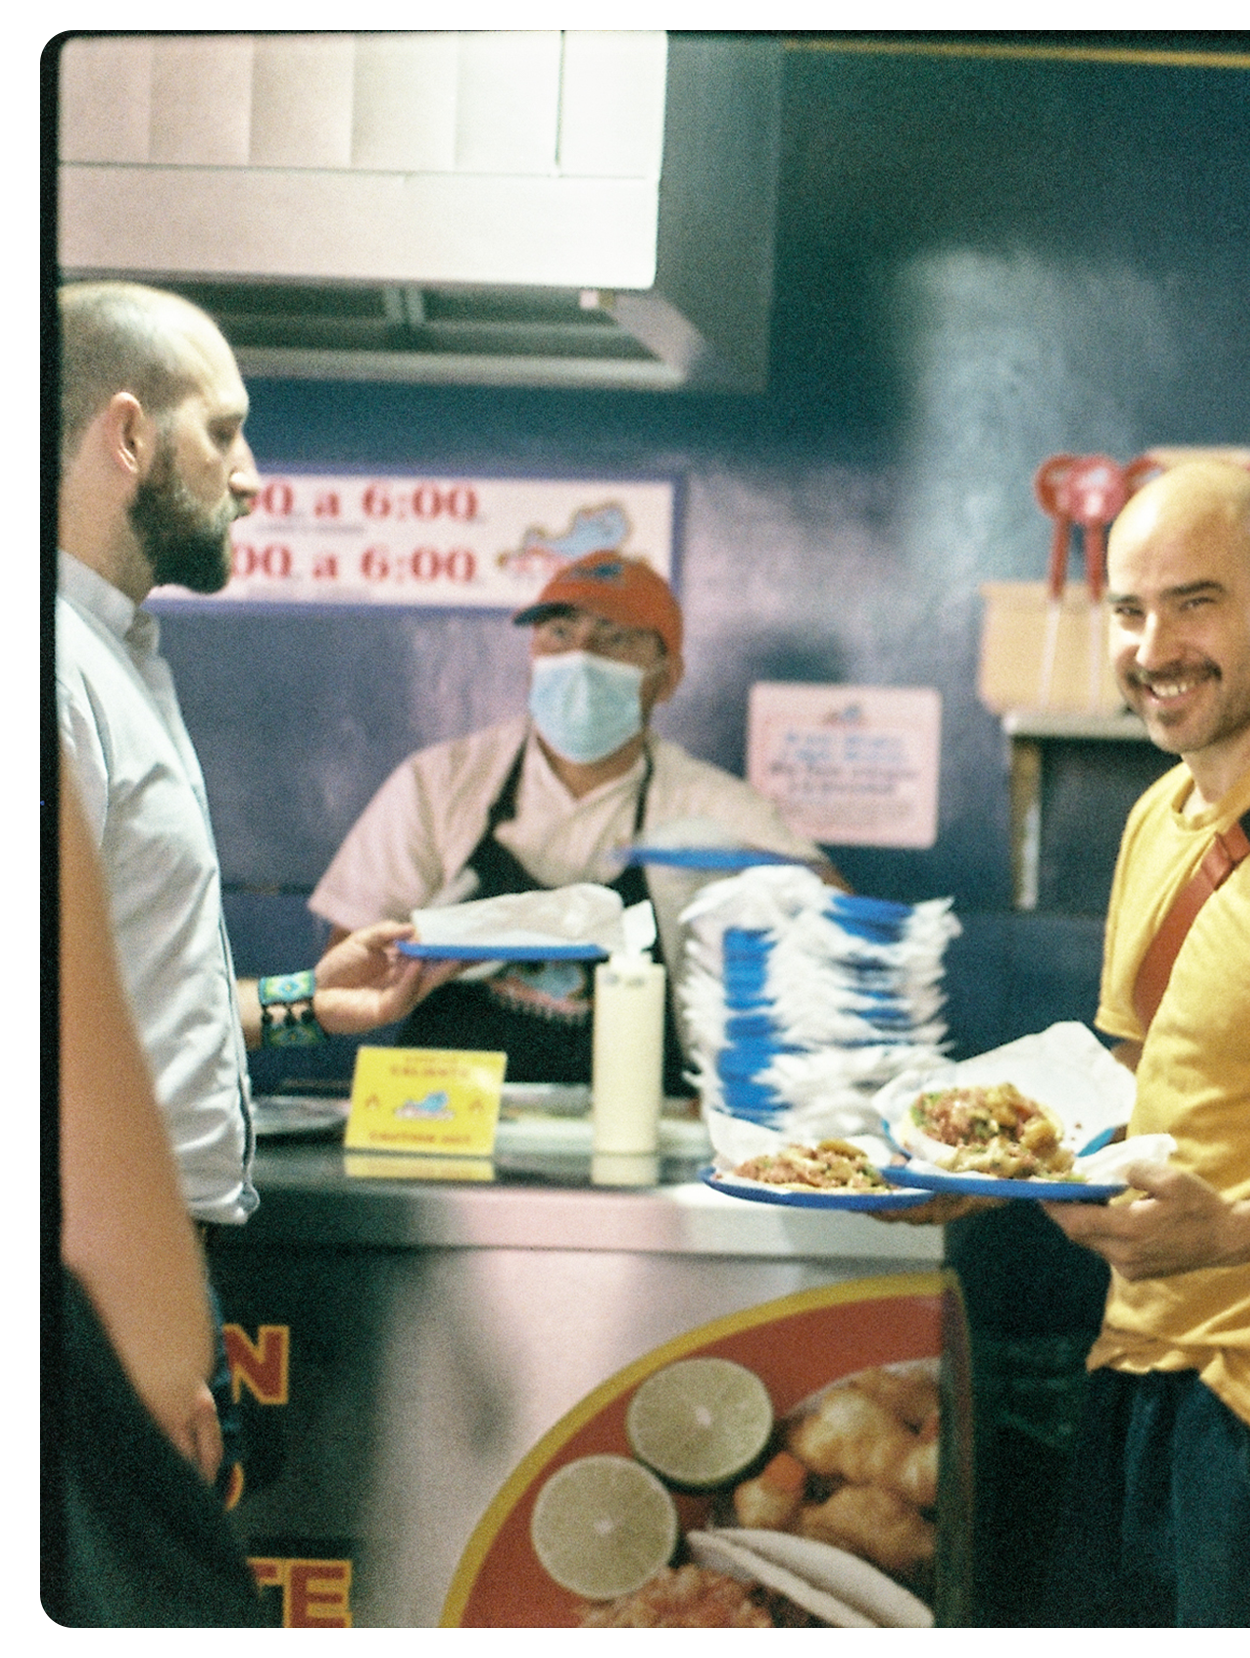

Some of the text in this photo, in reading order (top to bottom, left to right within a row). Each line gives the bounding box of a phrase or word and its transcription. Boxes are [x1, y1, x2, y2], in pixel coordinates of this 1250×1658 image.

[314, 491, 340, 519] a
[361, 482, 479, 521] 6:00
[312, 552, 339, 581] a
[360, 547, 477, 582] 6:00
[222, 1323, 290, 1405] N
